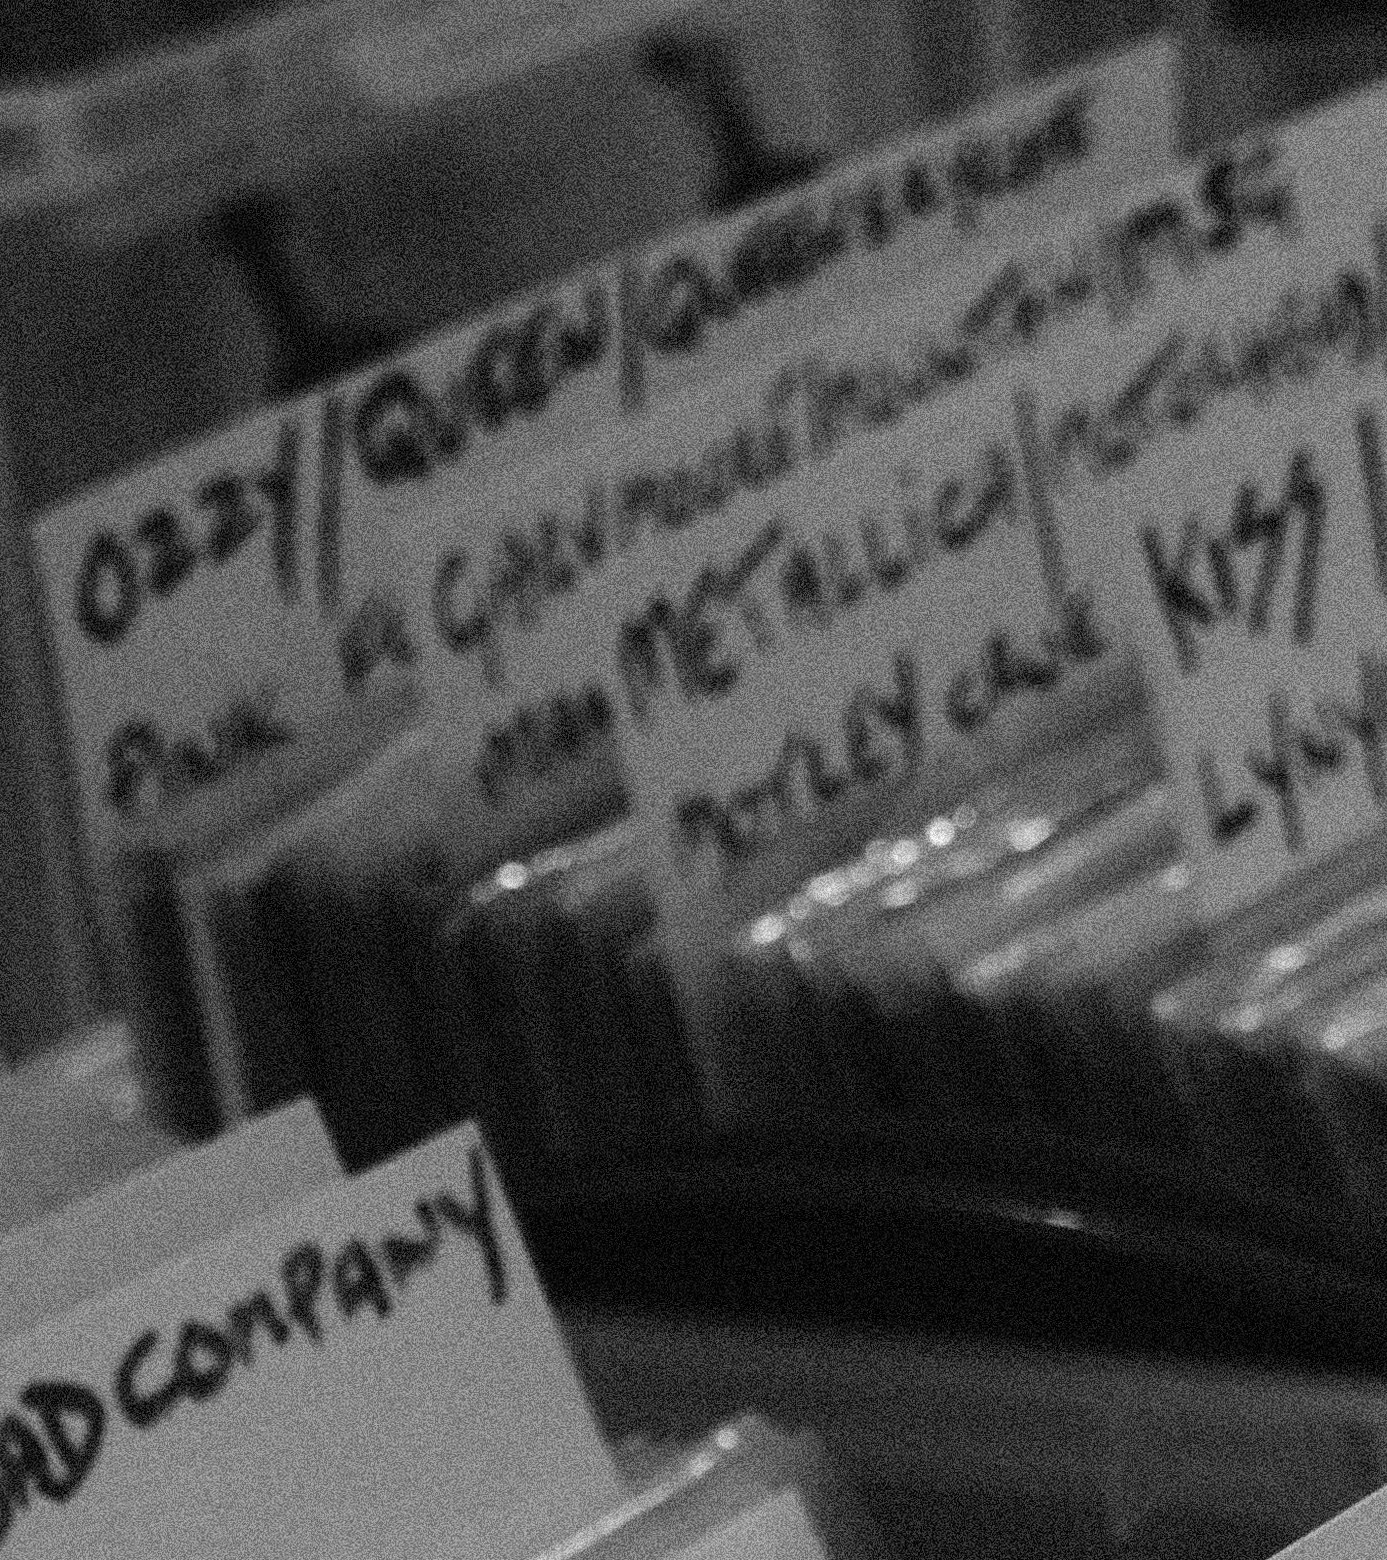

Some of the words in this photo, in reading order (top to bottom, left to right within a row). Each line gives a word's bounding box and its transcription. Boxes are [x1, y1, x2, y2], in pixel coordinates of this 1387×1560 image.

[77, 420, 298, 642] OZZY
[355, 285, 602, 483] QUEEN
[1144, 444, 1326, 674] KISS
[0, 1379, 105, 1546] AD
[114, 1138, 506, 1427] COMPANY
